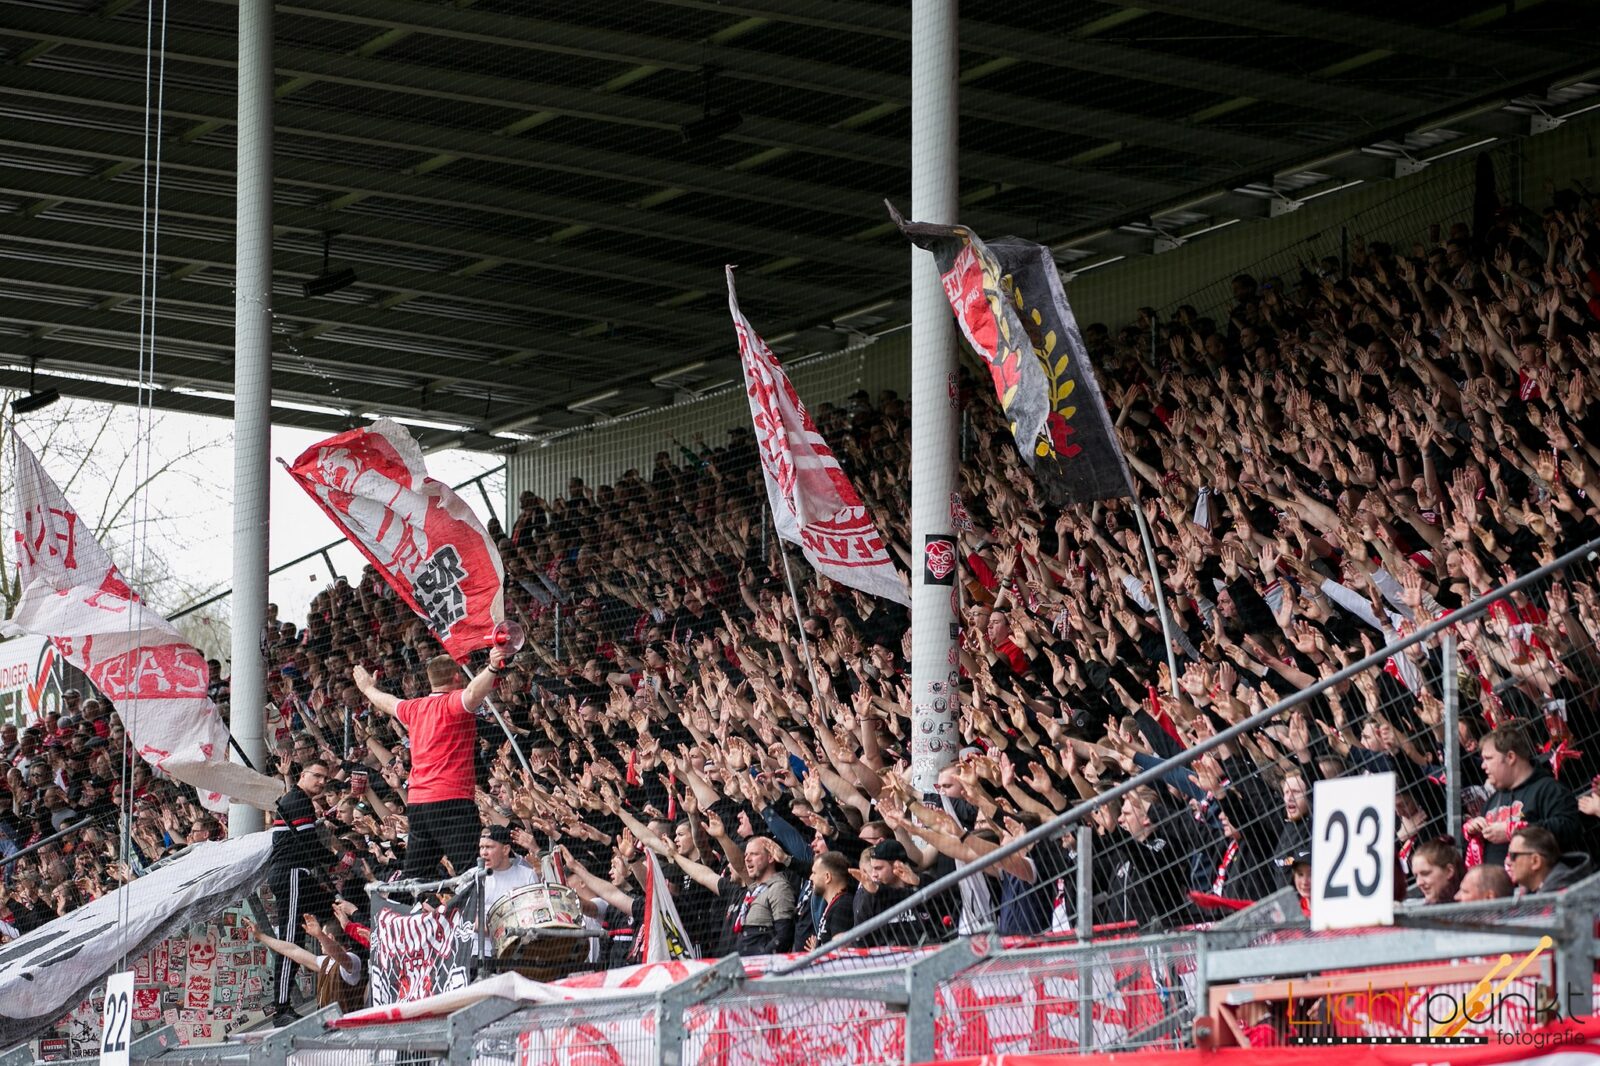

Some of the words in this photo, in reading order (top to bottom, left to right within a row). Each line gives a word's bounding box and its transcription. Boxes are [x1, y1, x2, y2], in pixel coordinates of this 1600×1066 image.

[0, 662, 29, 690] DIGER
[1324, 806, 1382, 899] 23
[104, 991, 128, 1053] 22
